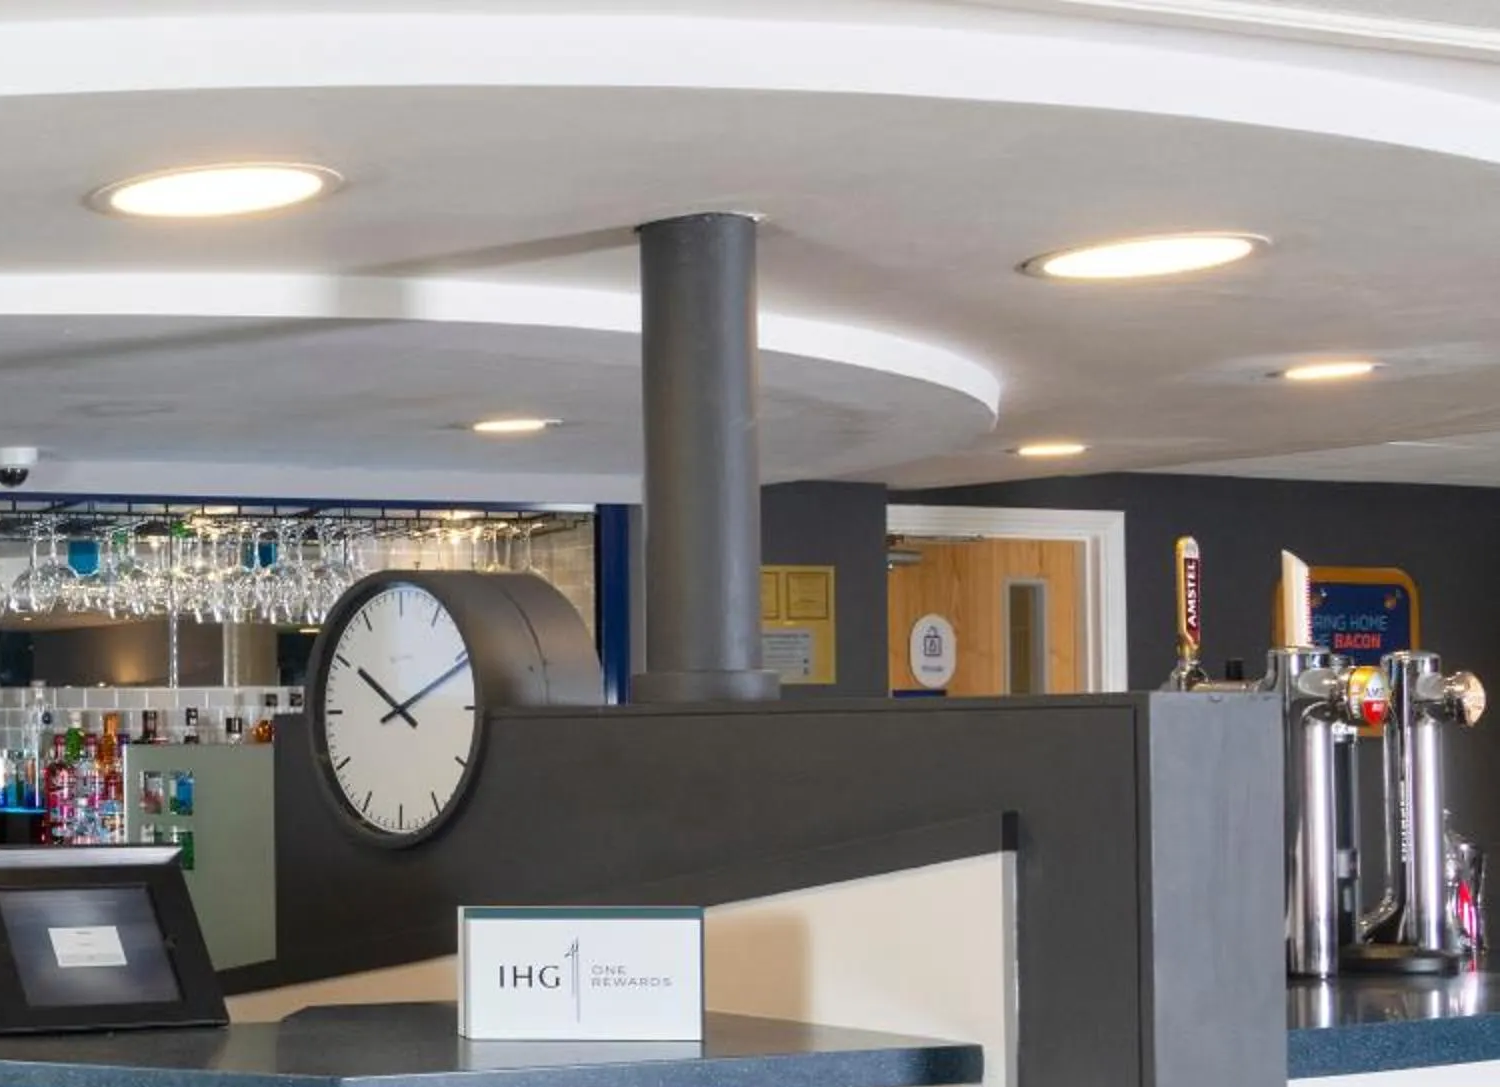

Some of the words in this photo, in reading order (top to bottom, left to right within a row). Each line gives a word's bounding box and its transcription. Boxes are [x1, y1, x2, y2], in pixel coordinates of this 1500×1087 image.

[1187, 560, 1198, 627] AMSTEL
[1313, 614, 1346, 631] RING
[1349, 614, 1389, 631] HOME
[1334, 632, 1381, 649] BACON
[499, 965, 561, 989] IHG
[591, 964, 626, 976] ONE
[591, 976, 672, 987] REWARDS
